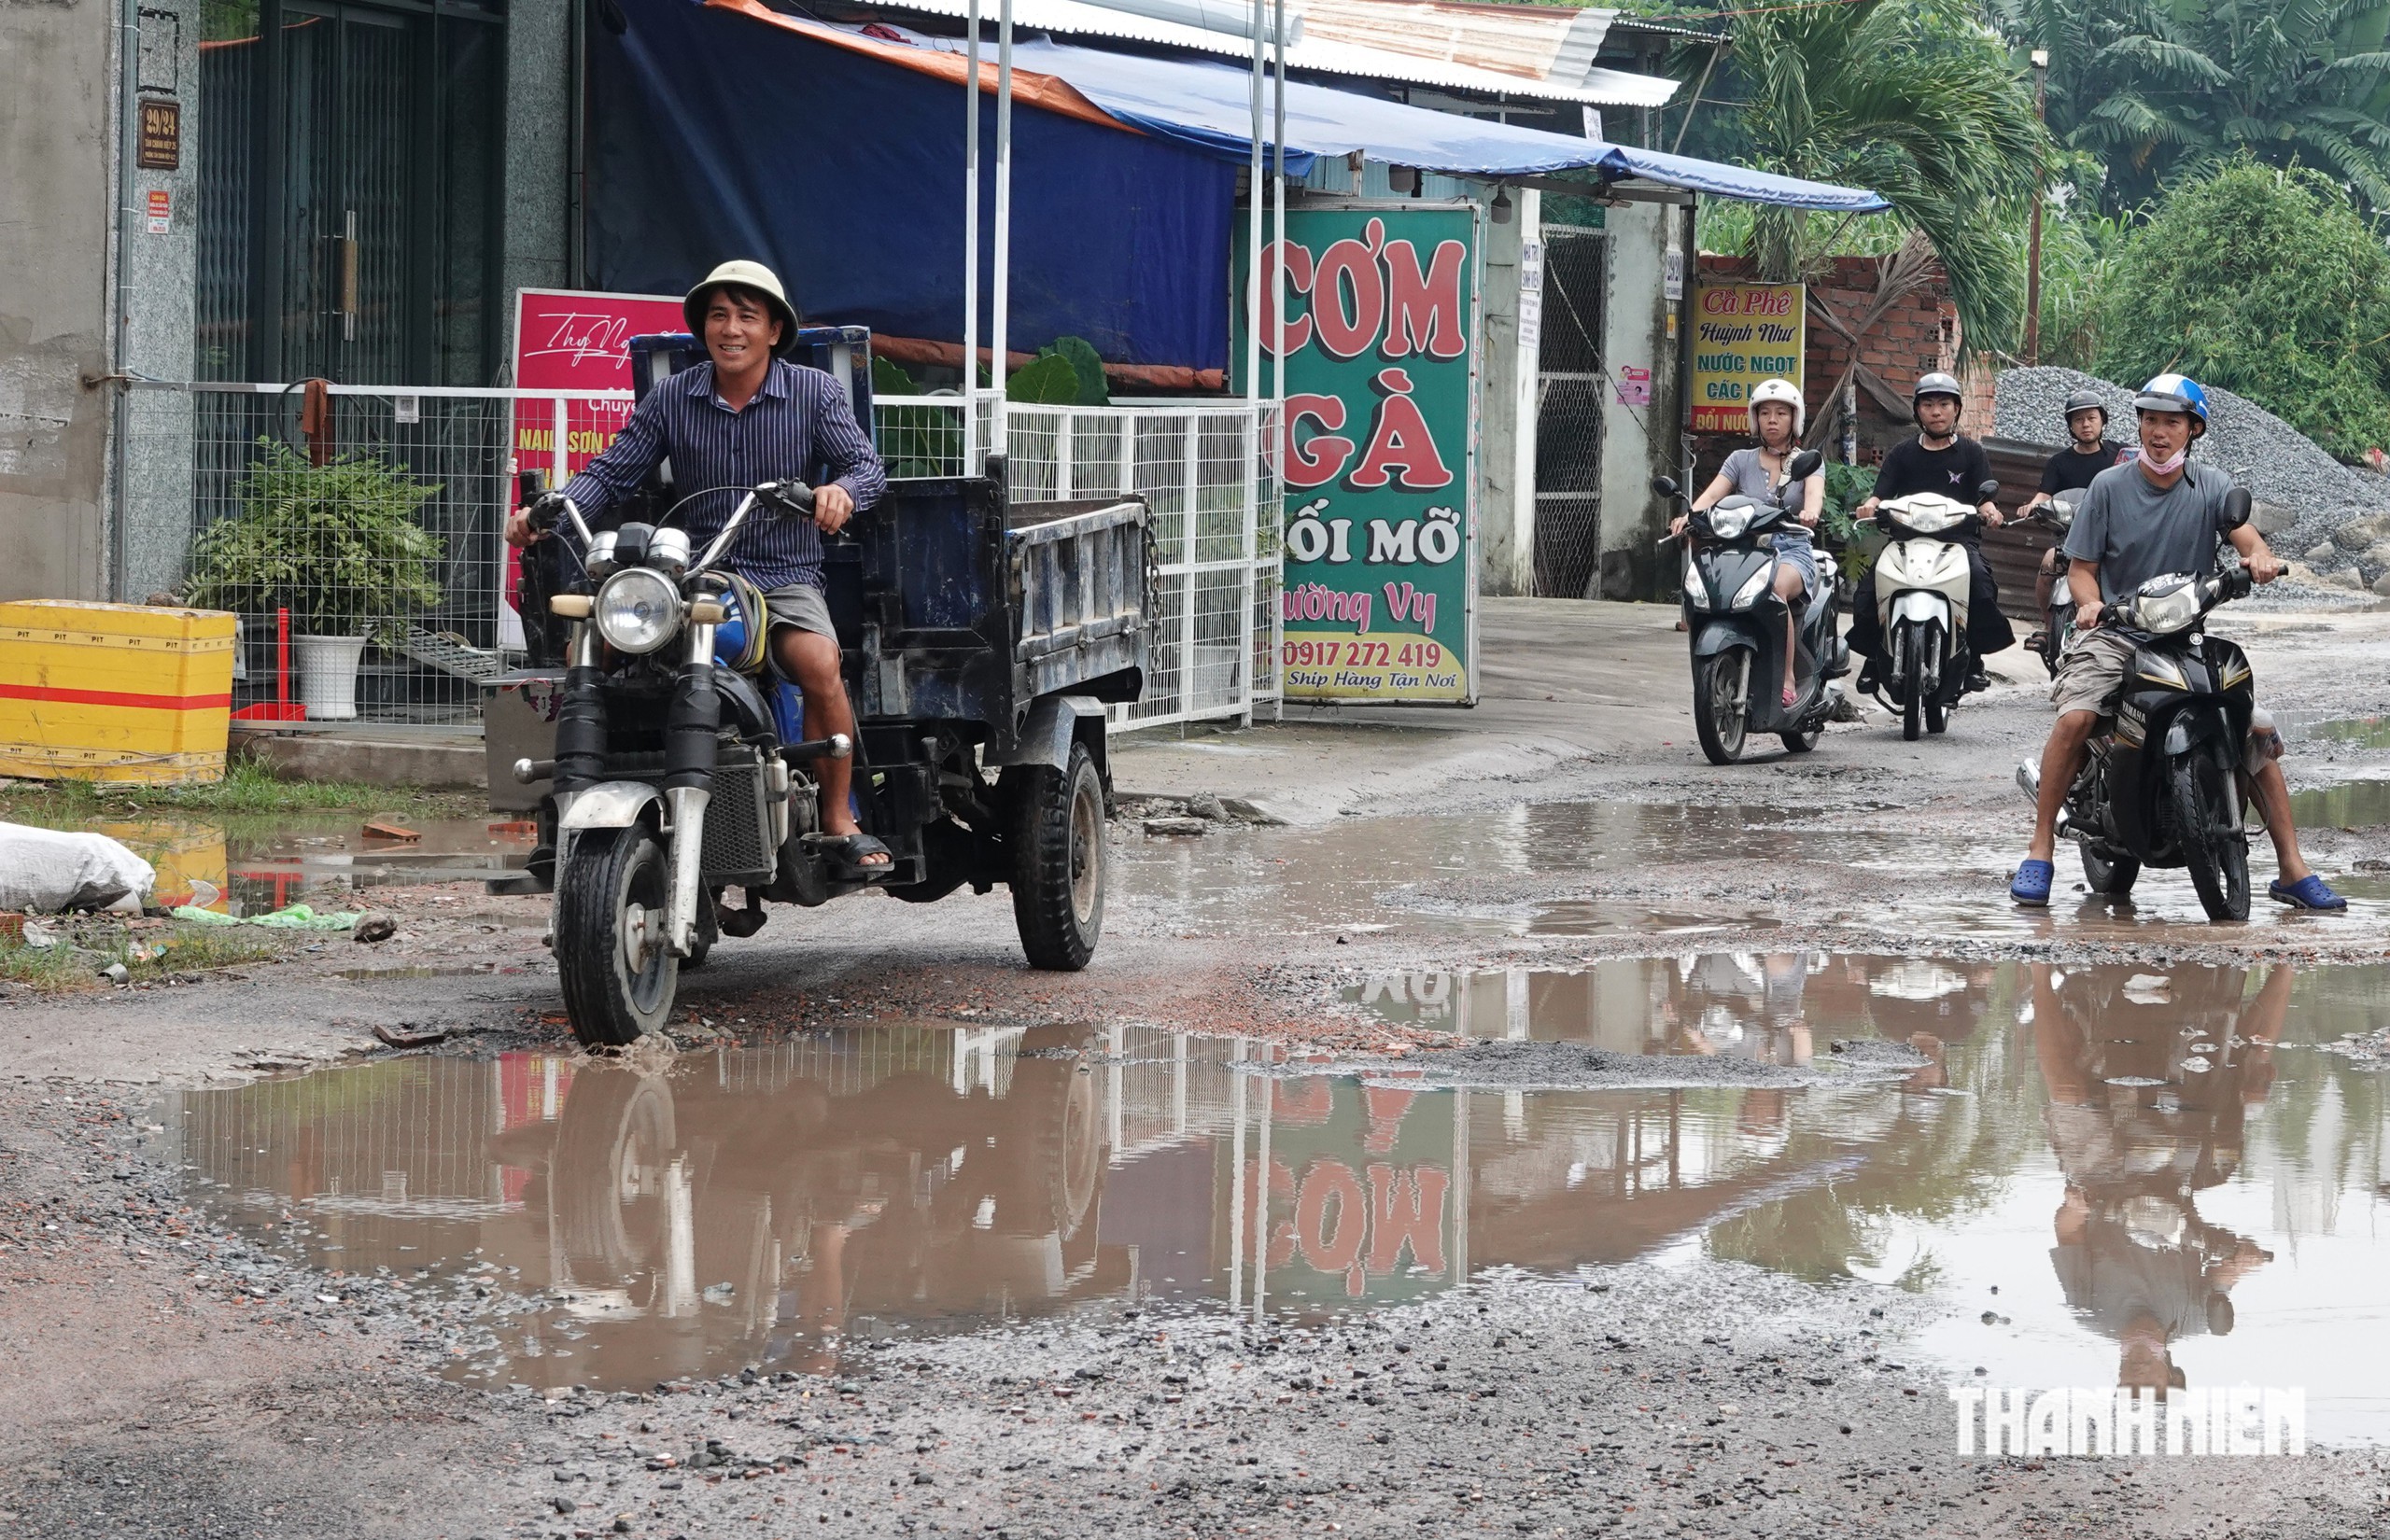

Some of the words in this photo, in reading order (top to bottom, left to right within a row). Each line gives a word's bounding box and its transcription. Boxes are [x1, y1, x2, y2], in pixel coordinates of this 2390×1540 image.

[147, 108, 176, 135] 29/24
[1247, 217, 1467, 357] CƠM
[1703, 289, 1738, 315] Cà
[1742, 289, 1793, 316] Phê
[1699, 322, 1753, 346] Huỳnh
[1758, 323, 1796, 343] Như
[1697, 352, 1746, 373] NƯỚC
[1750, 356, 1797, 378] NGỌT
[1707, 379, 1742, 400] CÁC
[1260, 368, 1454, 487] GÀ
[1695, 408, 1719, 430] ĐỔI
[568, 430, 603, 455] SƠN
[1286, 497, 1353, 562] ỐI
[1369, 506, 1461, 564] MỠ
[1282, 581, 1371, 635] ường
[1384, 581, 1437, 635] Vy
[1283, 640, 1340, 667] 0917
[1345, 641, 1390, 667] 272
[1398, 641, 1441, 668] 419
[1287, 670, 1329, 690] Ship
[1333, 670, 1382, 689] Hàng
[1388, 671, 1419, 689] Tận
[1425, 672, 1456, 688] Nơi
[2122, 700, 2146, 723] YAMAHA
